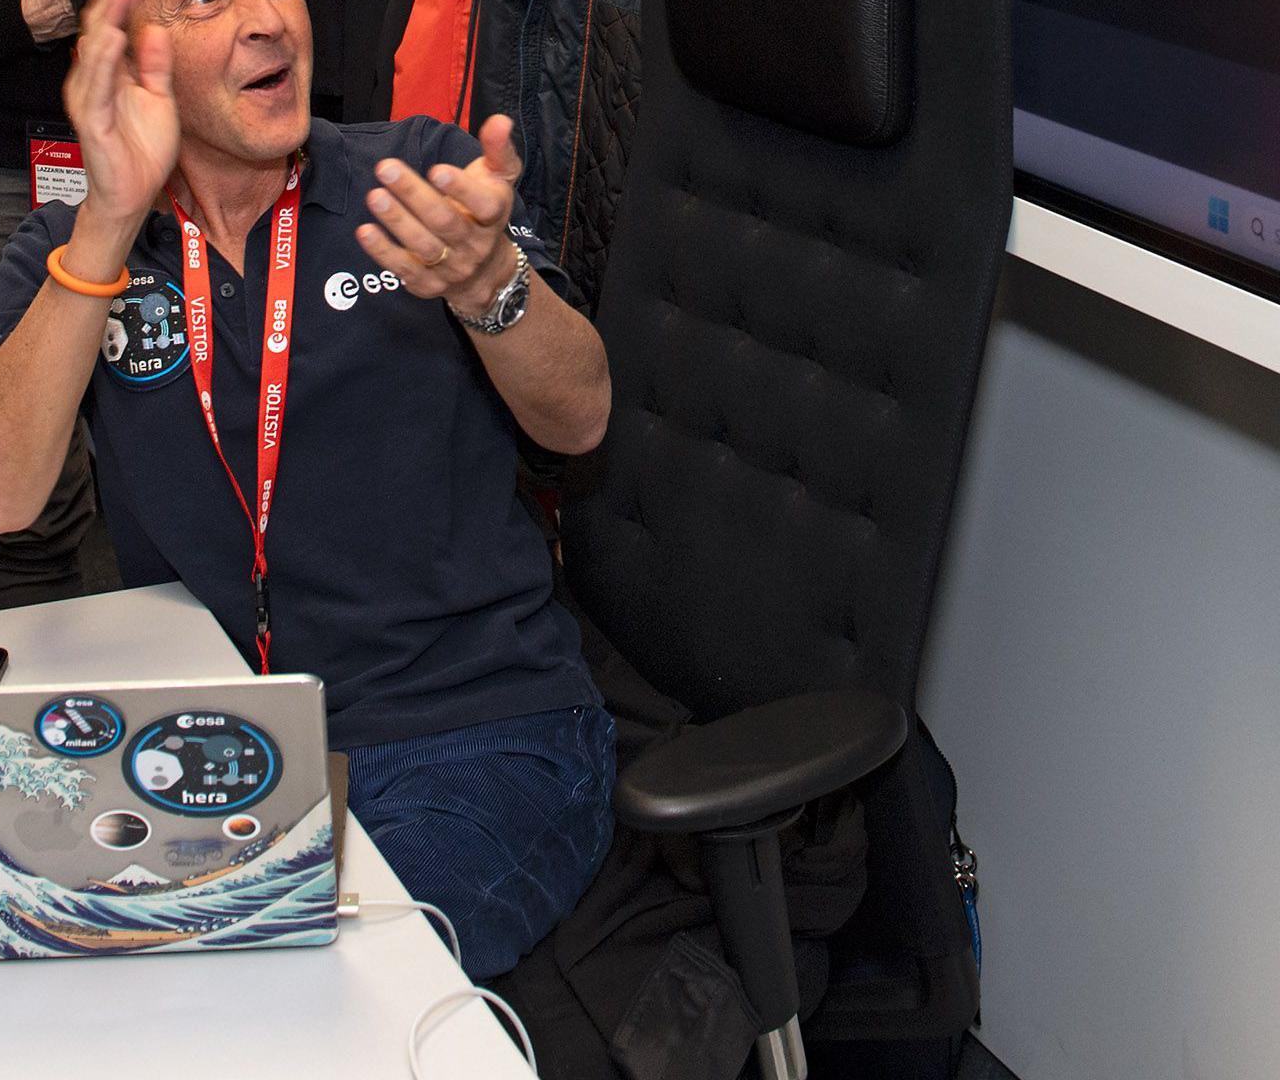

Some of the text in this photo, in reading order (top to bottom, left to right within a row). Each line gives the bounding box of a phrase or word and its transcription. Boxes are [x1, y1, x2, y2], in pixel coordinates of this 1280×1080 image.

[49, 151, 72, 159] VISITOR
[275, 206, 294, 270] VISITOR
[132, 274, 155, 286] esa
[190, 296, 208, 363] VISITOR
[129, 357, 162, 374] hera
[264, 383, 282, 450] VISITOR
[65, 737, 97, 748] milani
[181, 790, 228, 804] hera
